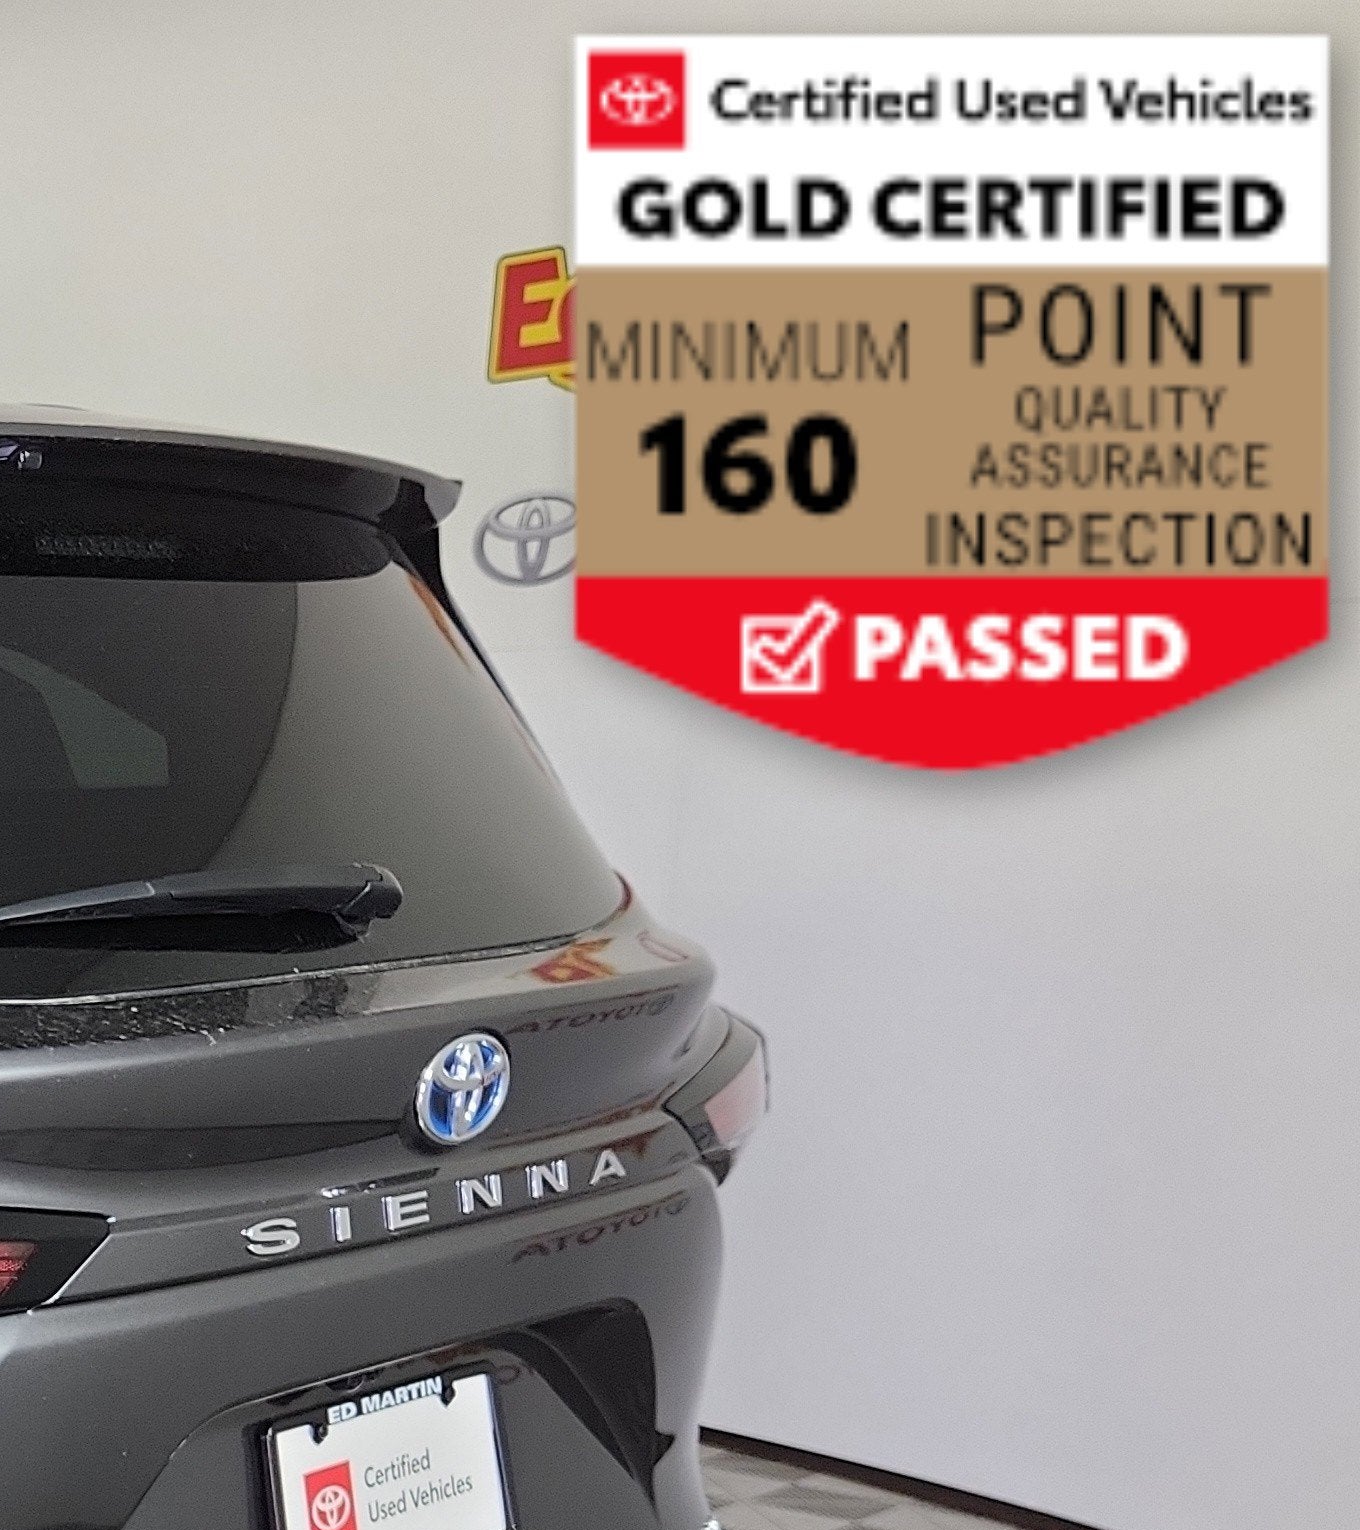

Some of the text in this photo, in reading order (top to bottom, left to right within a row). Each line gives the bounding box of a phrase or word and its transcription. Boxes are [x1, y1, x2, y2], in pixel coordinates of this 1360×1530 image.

[242, 1149, 627, 1257] SIENNA
[327, 1376, 444, 1425] ED MARTIN
[363, 1449, 432, 1488] Certified
[368, 1473, 474, 1523] Used Vehicles
